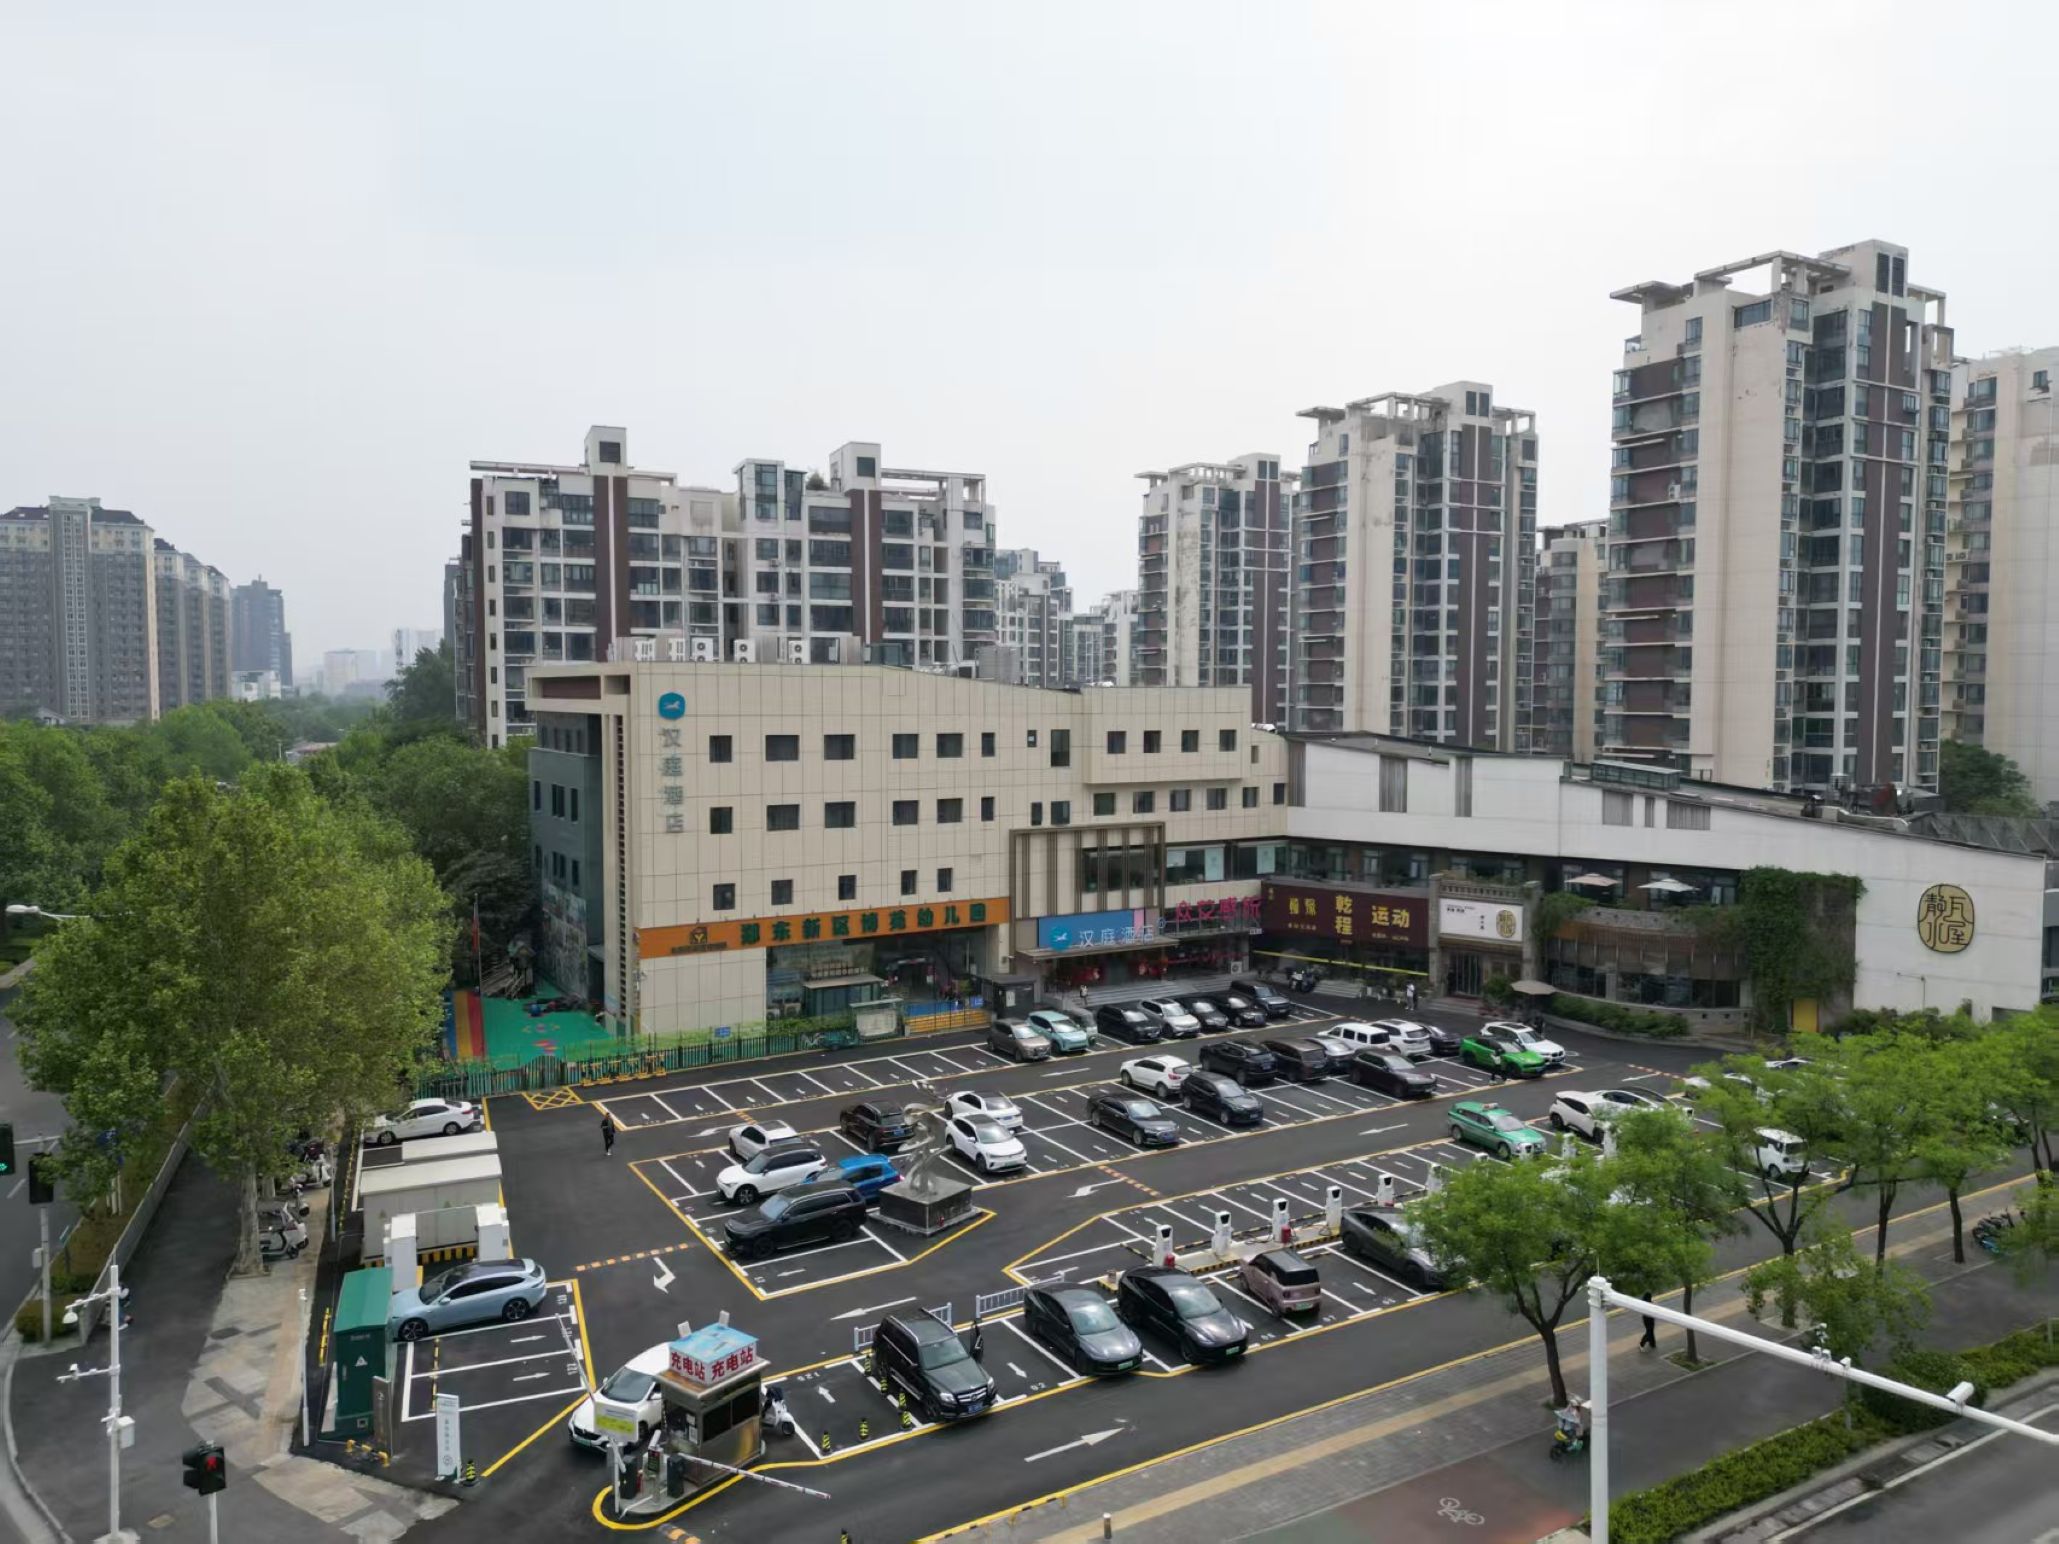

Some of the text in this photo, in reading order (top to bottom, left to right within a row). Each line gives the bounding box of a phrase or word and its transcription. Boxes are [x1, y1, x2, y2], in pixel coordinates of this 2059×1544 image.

[1371, 905, 1410, 928] 运动
[1079, 926, 1154, 948] 汉庭酒店
[671, 1351, 705, 1381] 充电站
[711, 1346, 753, 1381] 充电站
